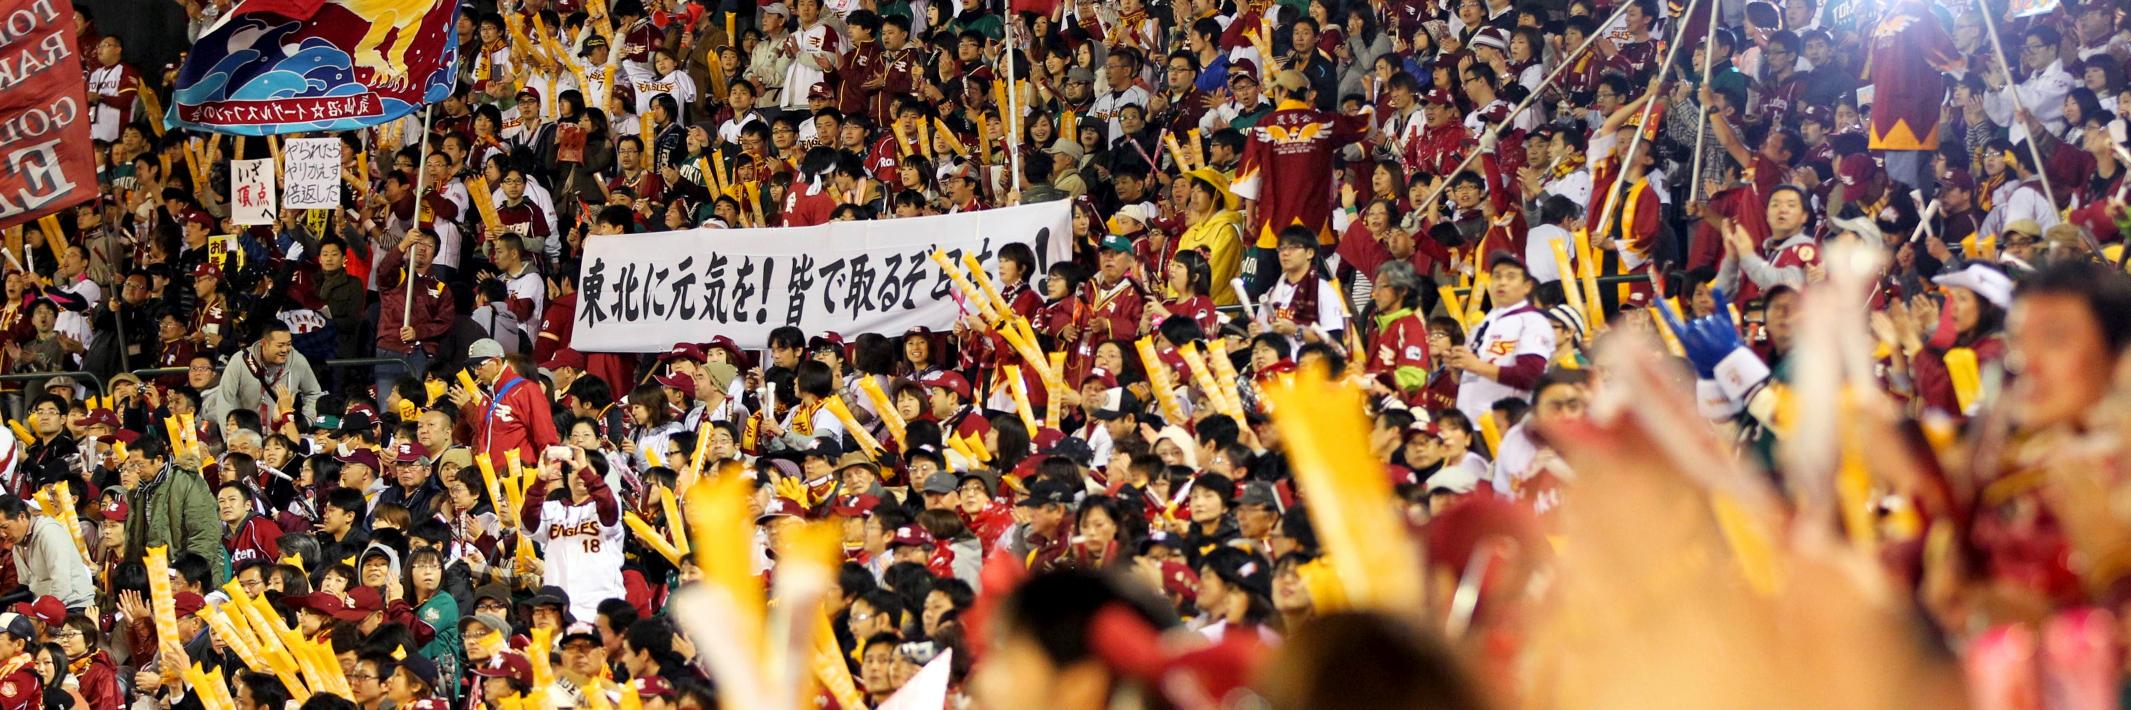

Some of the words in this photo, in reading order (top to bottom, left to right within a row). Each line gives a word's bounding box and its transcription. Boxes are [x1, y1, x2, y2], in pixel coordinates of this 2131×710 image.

[286, 141, 340, 160] やられたら
[238, 161, 262, 182] いざ
[286, 163, 340, 180] やりかえす
[237, 182, 269, 207] 頂点
[285, 182, 340, 204] 倍返しだ
[261, 208, 274, 219] へ
[549, 520, 600, 540] EAGLES
[582, 539, 600, 553] 18
